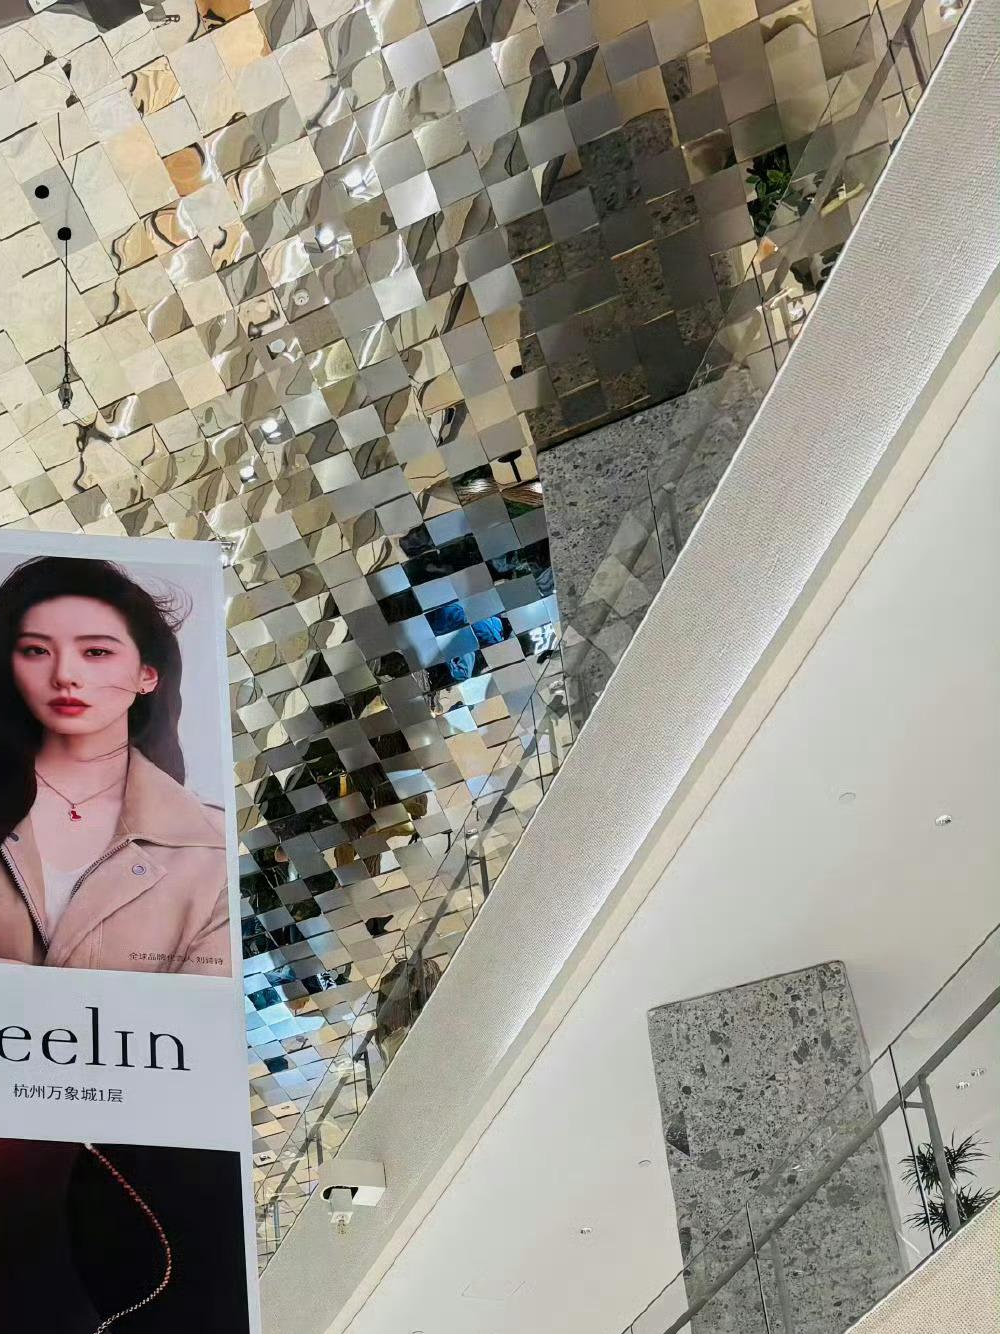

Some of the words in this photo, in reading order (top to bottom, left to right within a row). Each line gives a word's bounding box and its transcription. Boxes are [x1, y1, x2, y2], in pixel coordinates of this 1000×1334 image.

[13, 1083, 123, 1103] 杭州万象城1层
